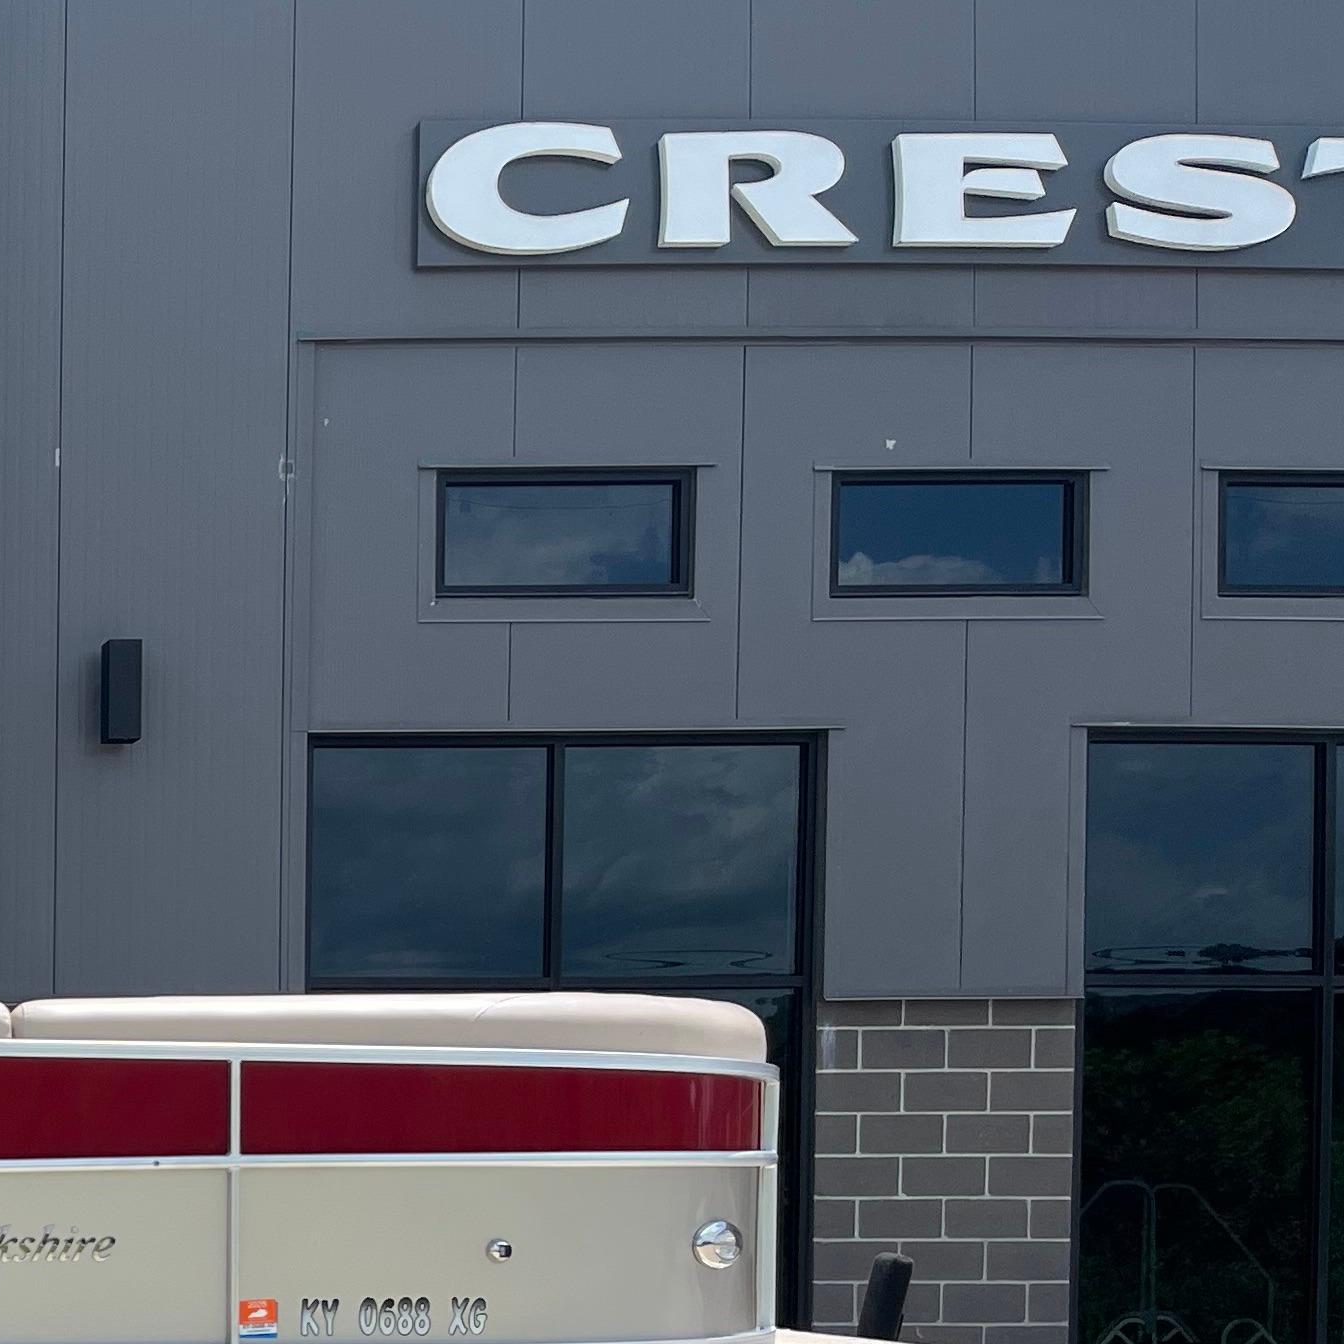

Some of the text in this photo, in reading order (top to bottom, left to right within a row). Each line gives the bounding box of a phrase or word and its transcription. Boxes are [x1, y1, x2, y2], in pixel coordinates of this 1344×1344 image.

[425, 120, 1344, 255] CRES
[300, 1296, 488, 1337] KY 0688 XG
